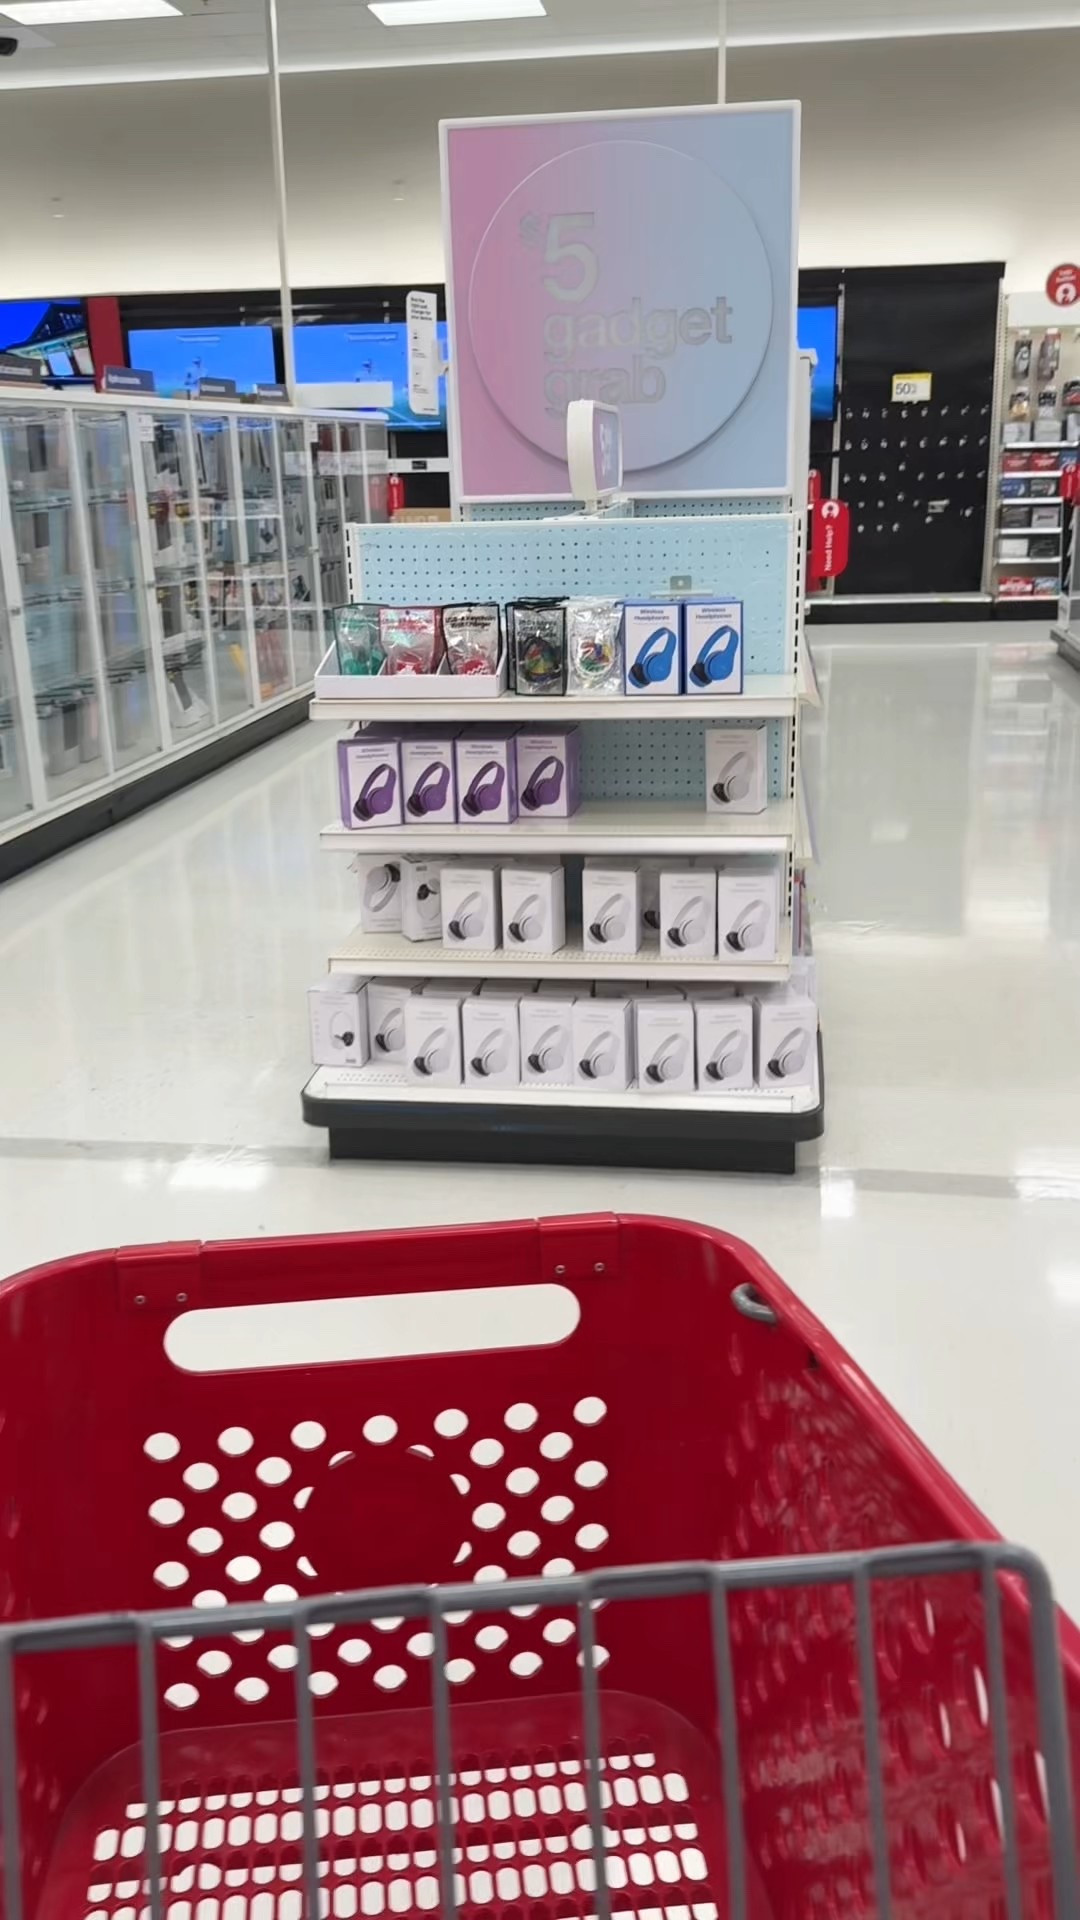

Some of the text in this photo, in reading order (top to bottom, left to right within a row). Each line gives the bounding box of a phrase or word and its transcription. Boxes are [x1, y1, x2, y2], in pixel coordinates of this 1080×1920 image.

[518, 211, 598, 303] $5
[543, 296, 733, 361] gadget
[543, 353, 667, 420] grab
[824, 524, 834, 572] Need Help?
